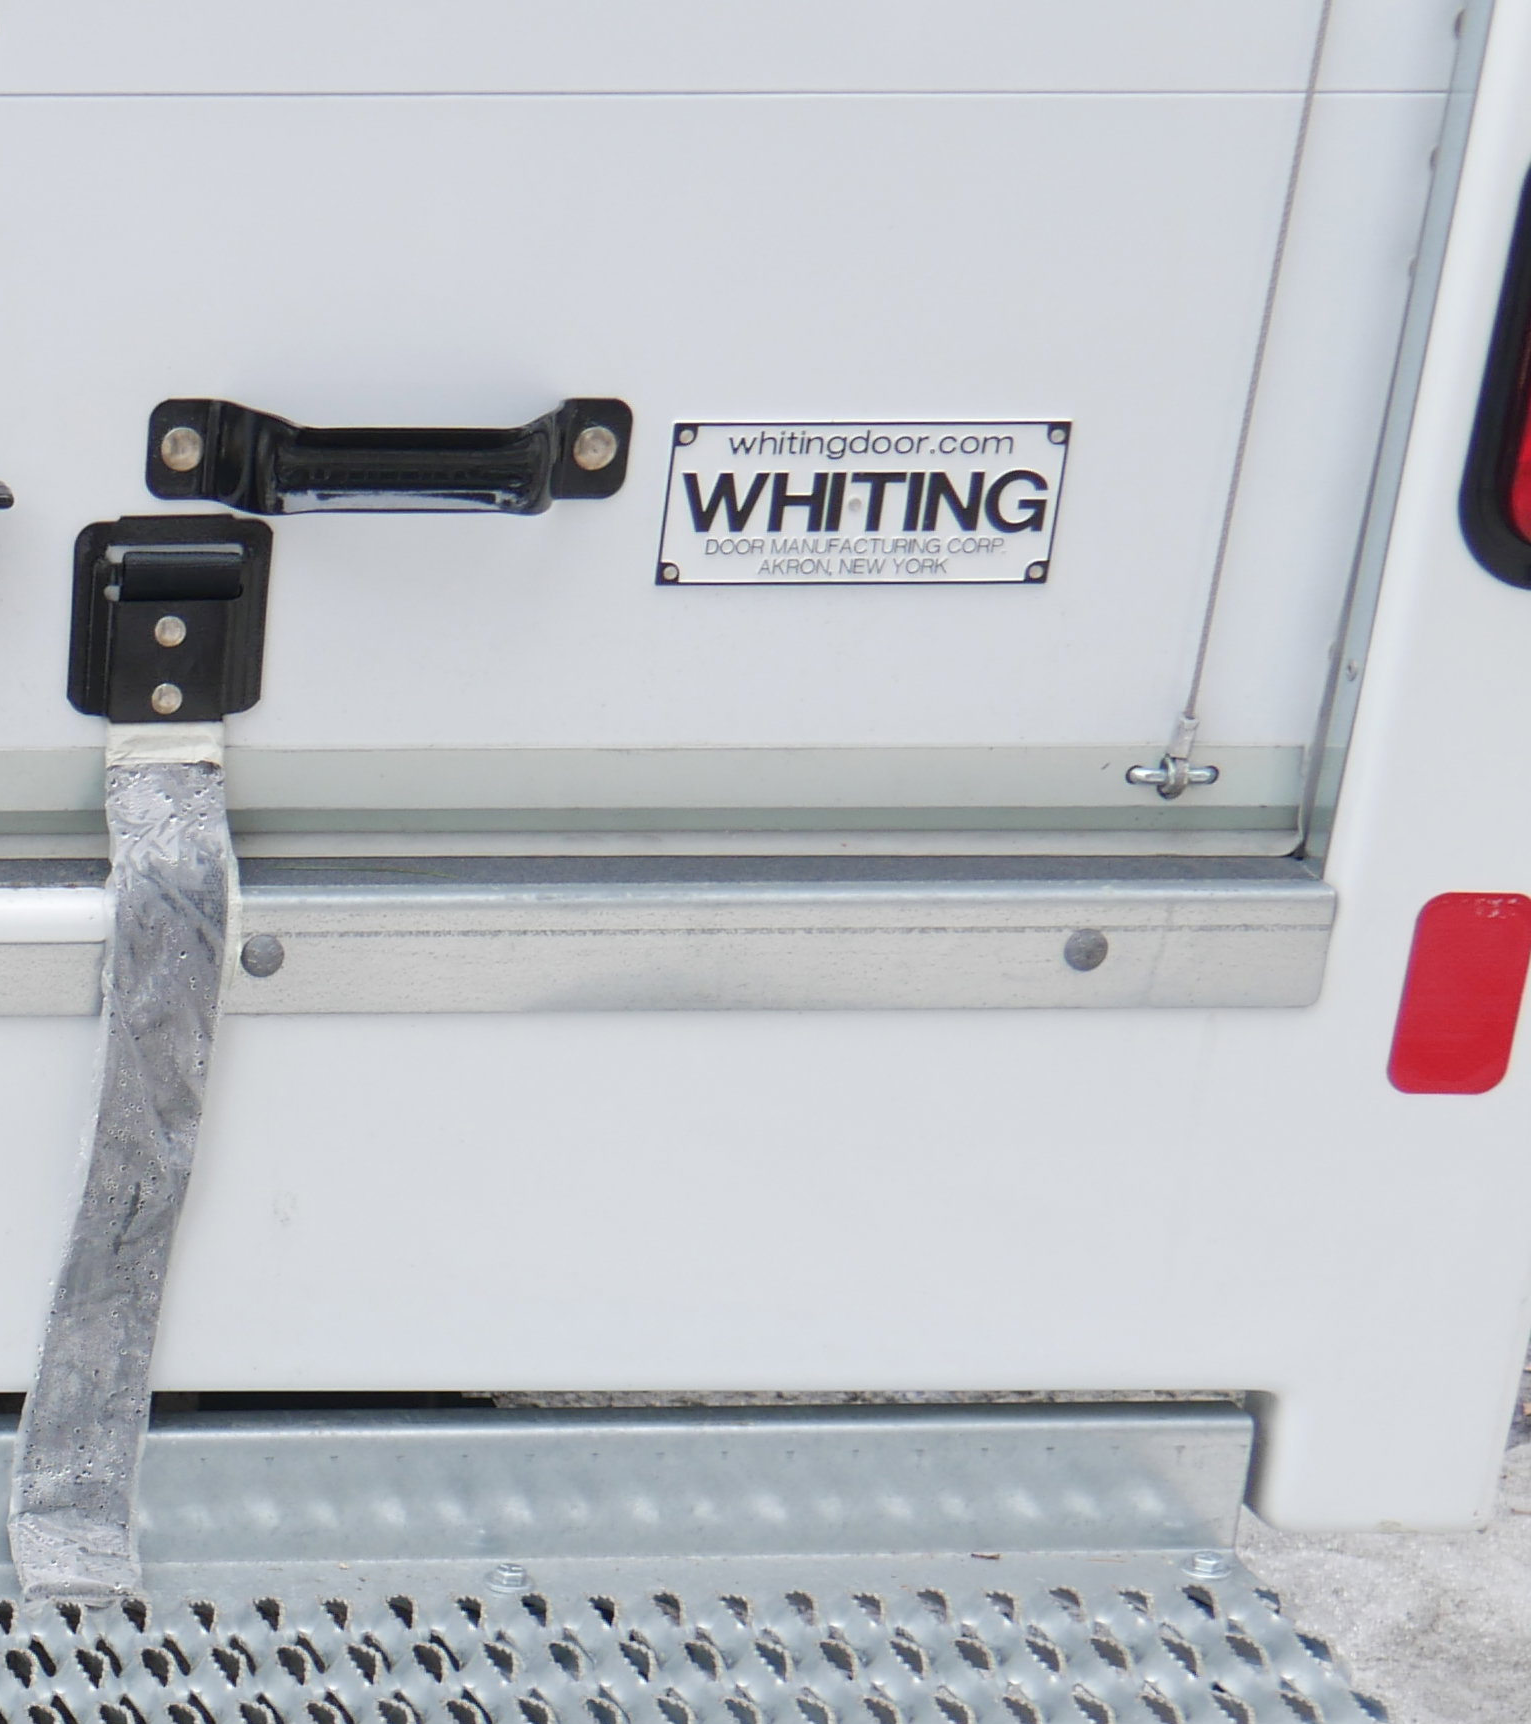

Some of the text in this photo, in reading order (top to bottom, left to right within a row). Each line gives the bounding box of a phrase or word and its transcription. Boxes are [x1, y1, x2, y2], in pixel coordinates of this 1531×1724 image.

[729, 430, 1015, 459] whitingdoor.com
[682, 470, 1049, 534] WHITING
[705, 537, 1006, 555] DOOR MANUFACTURING CORP.
[757, 558, 949, 576] AKRON, NEW YORK
